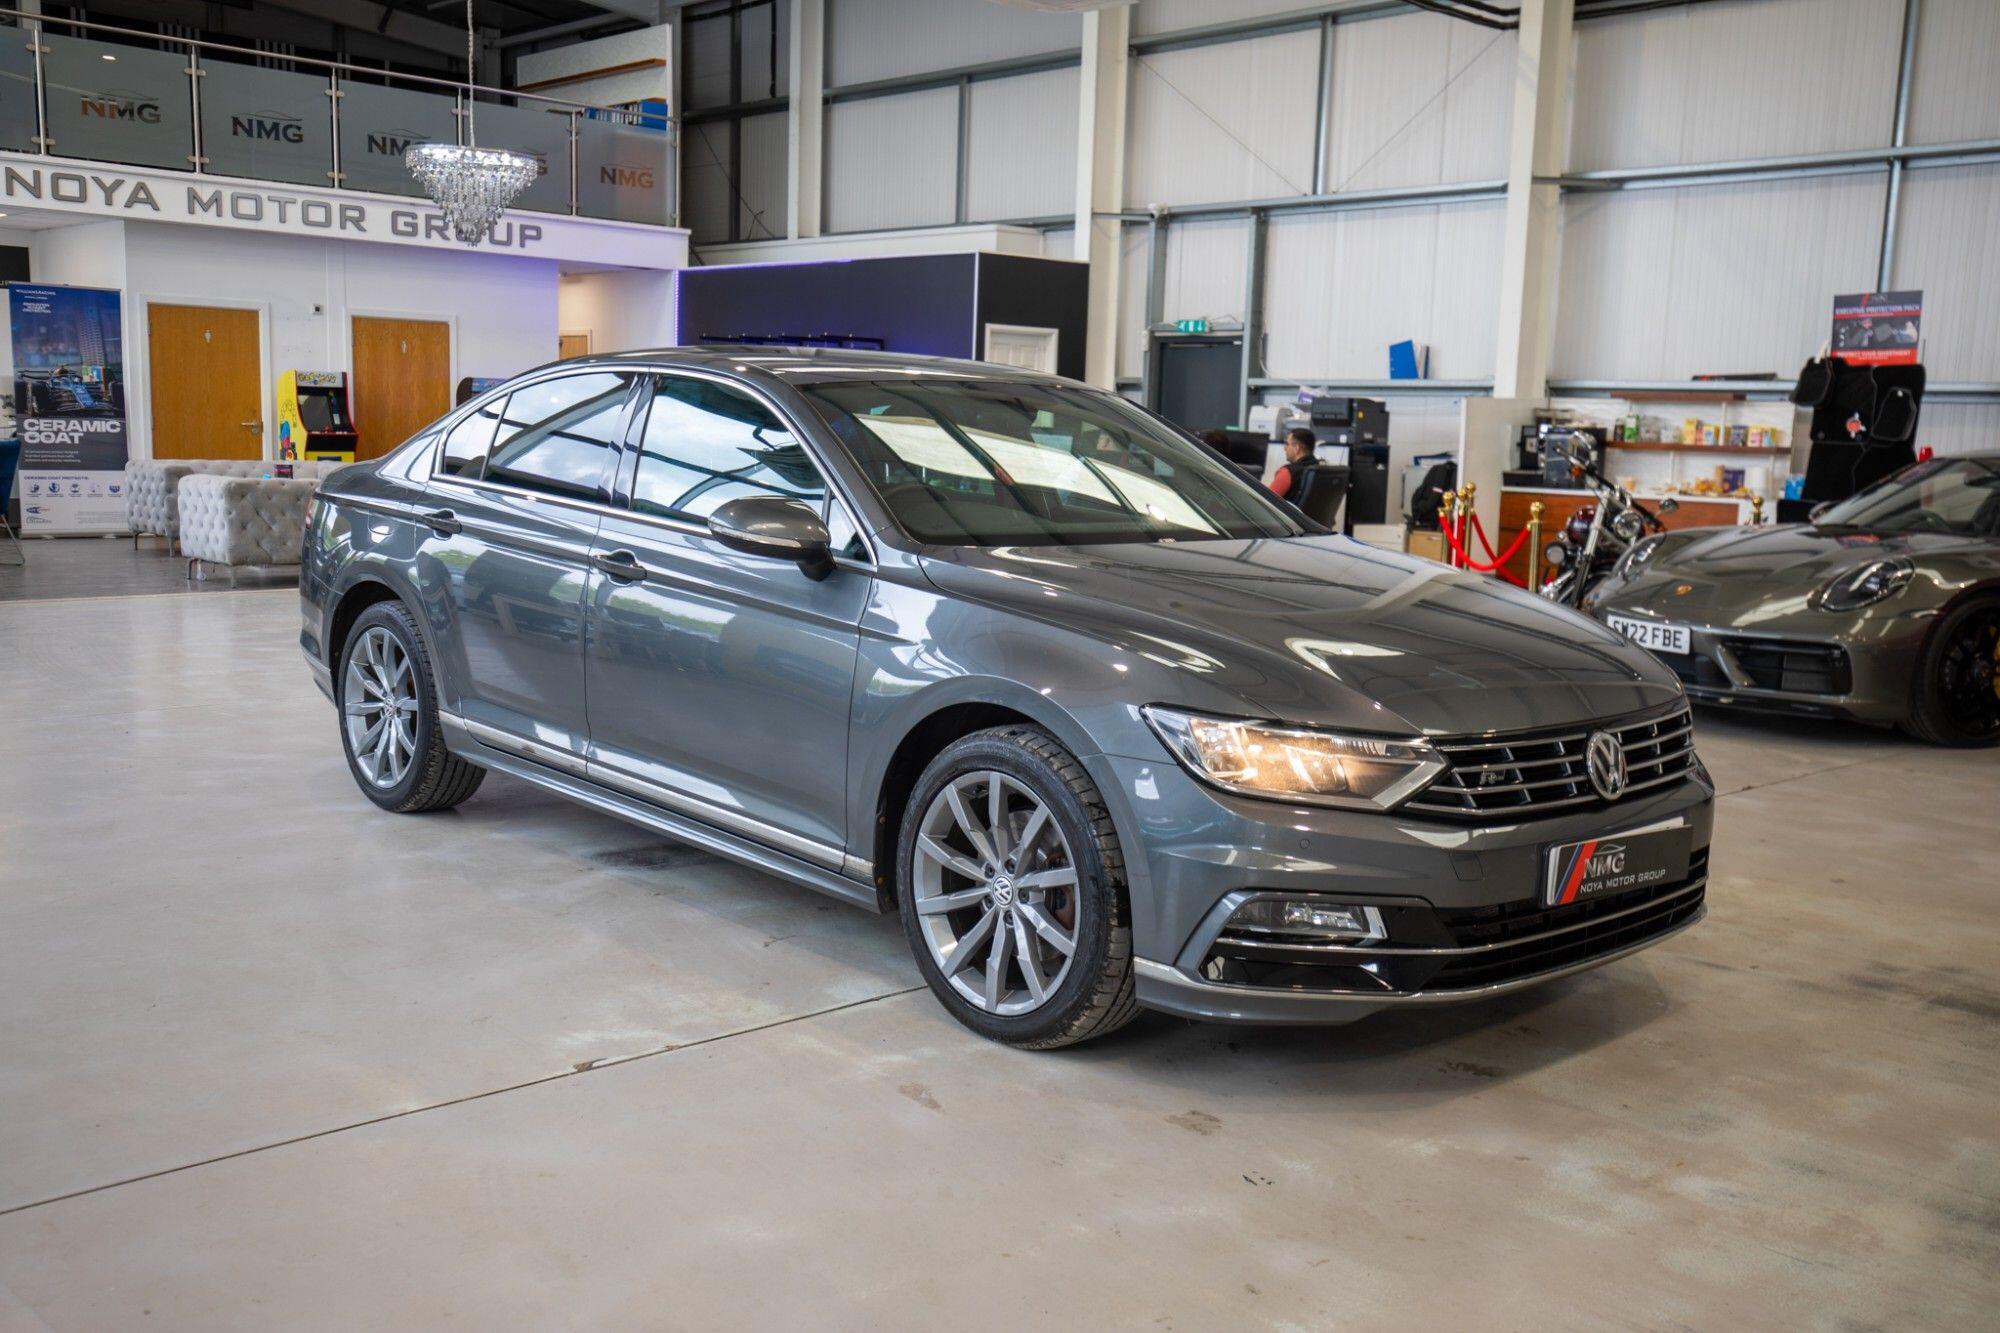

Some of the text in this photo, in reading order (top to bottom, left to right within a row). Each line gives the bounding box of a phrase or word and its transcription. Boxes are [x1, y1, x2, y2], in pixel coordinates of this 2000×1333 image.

[81, 96, 162, 124] NMG
[232, 116, 304, 143] NMG
[600, 166, 654, 189] NMG
[5, 167, 161, 212] NOYA
[187, 187, 368, 233] MOTOR
[23, 419, 121, 433] CERAMIC
[24, 432, 84, 444] COAT
[1651, 626, 1683, 649] FBE
[1583, 852, 1625, 880] NMG
[1580, 868, 1666, 894] NOYA MOTOR GROUP
